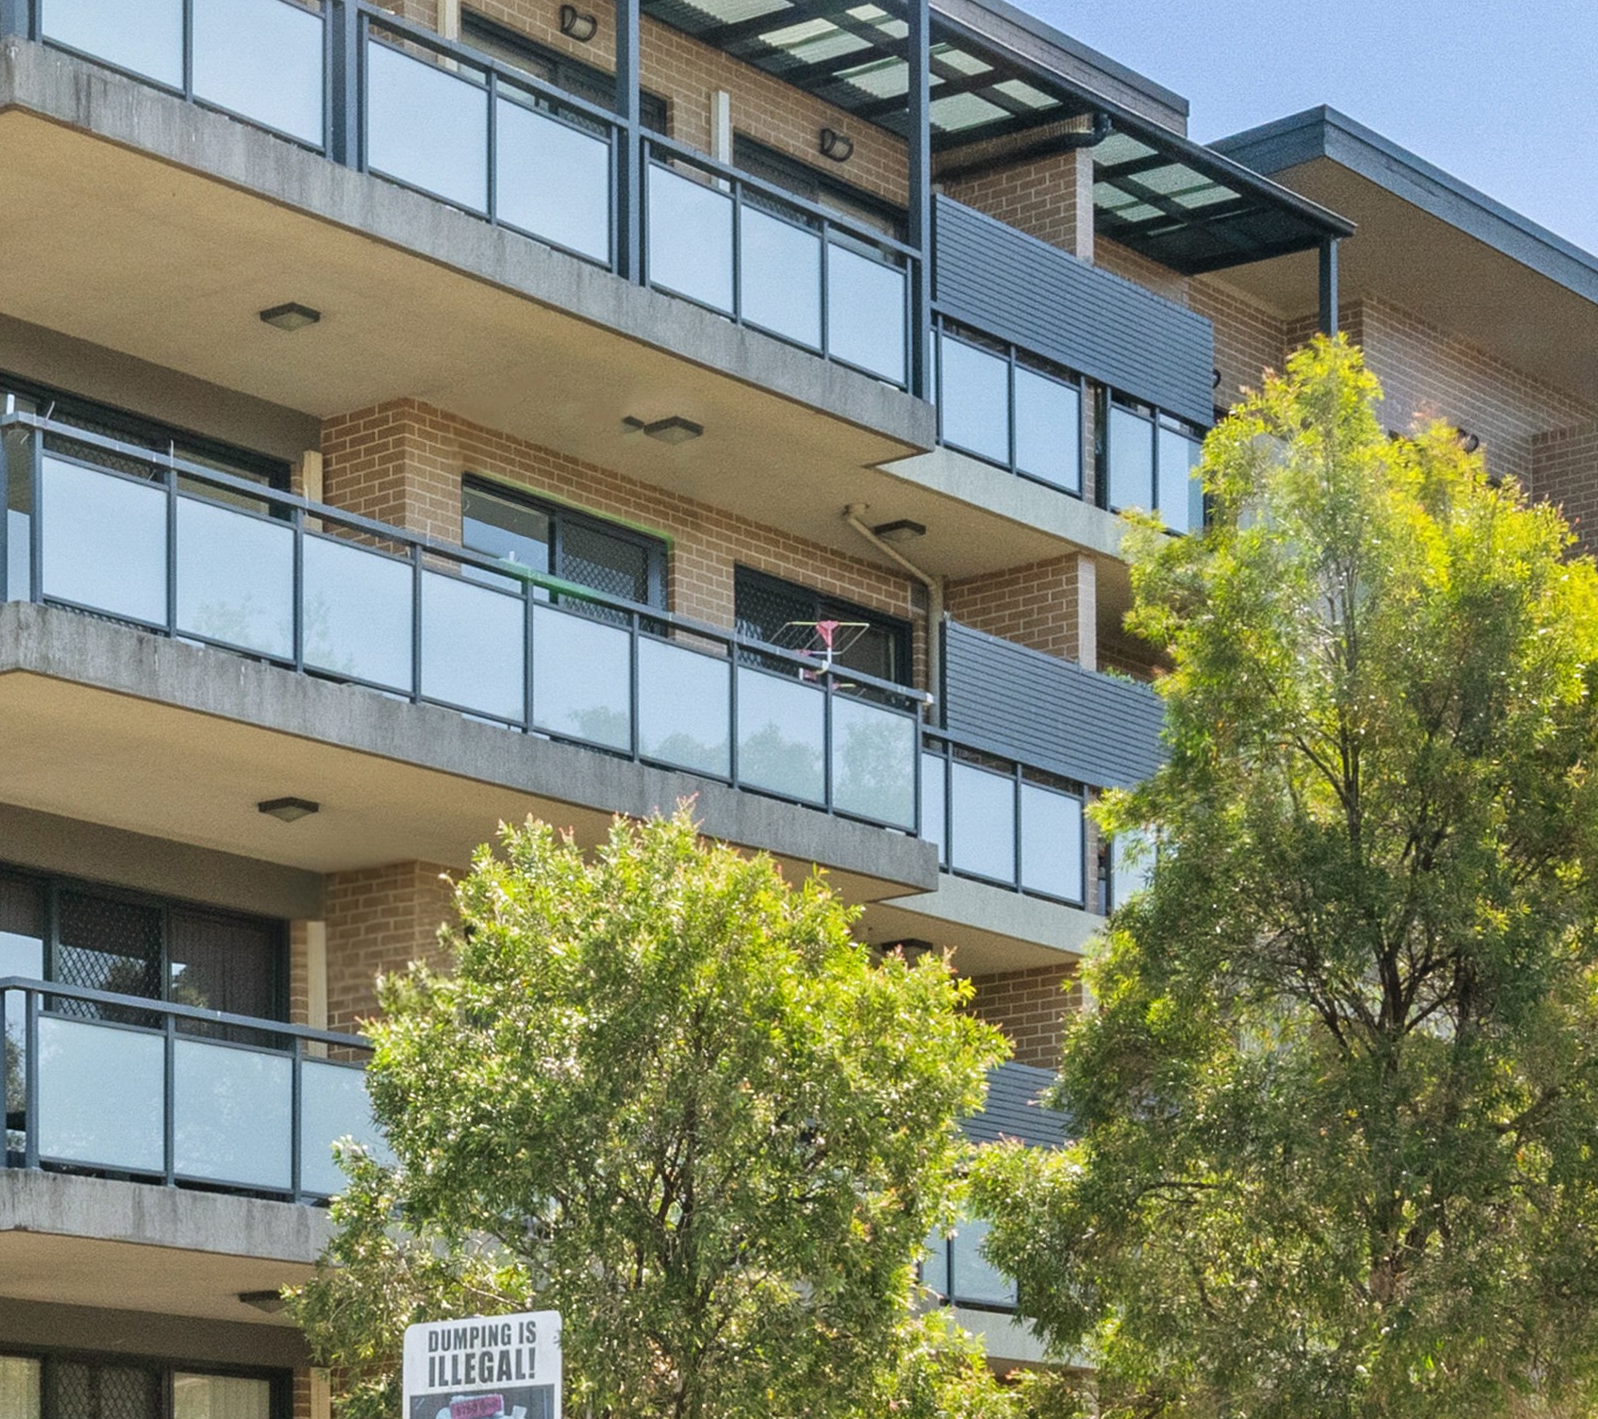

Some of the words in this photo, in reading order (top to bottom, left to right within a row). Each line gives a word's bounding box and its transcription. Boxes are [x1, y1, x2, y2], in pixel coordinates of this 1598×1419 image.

[428, 1325, 512, 1352] DUMPING
[519, 1321, 537, 1344] IS
[428, 1348, 536, 1388] ILLEGAL!
